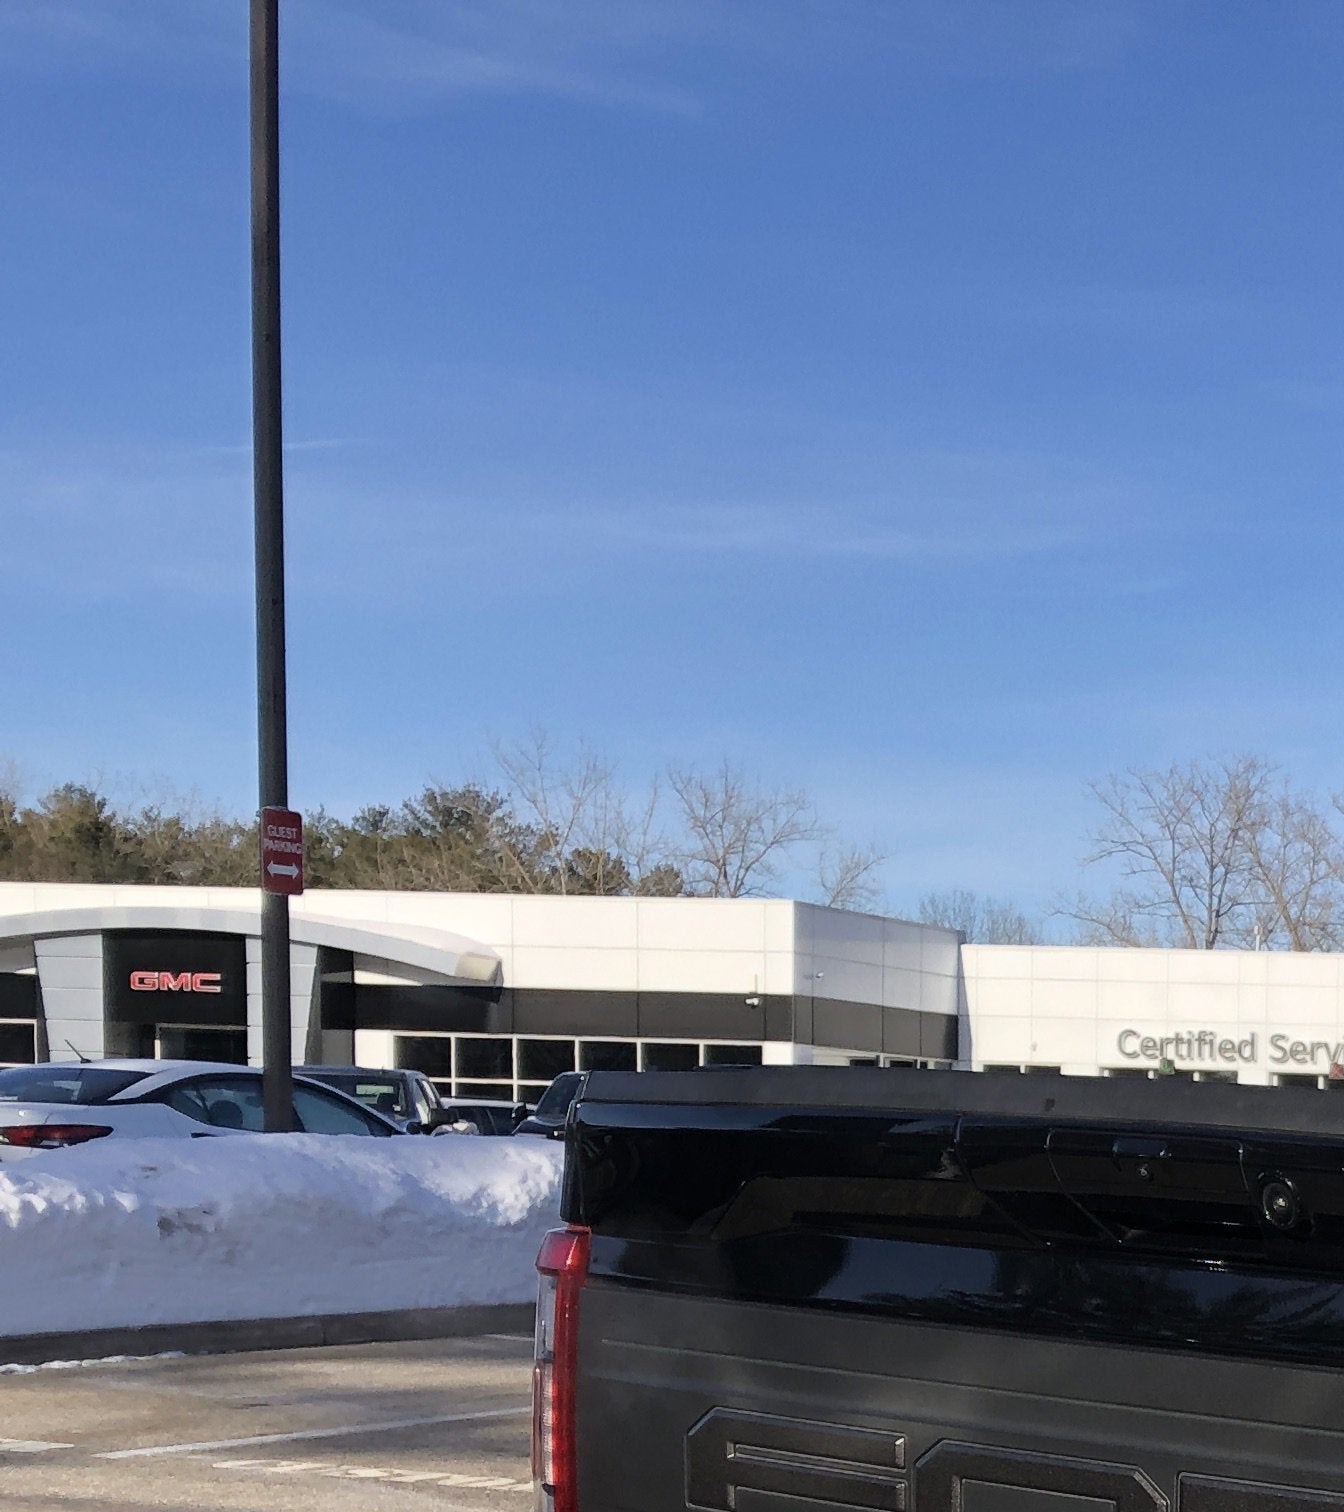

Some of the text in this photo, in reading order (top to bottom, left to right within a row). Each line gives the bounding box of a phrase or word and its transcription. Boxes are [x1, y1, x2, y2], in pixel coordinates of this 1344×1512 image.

[267, 825, 298, 839] GUEST
[130, 970, 221, 992] GMC
[1117, 1029, 1257, 1063] Certified
